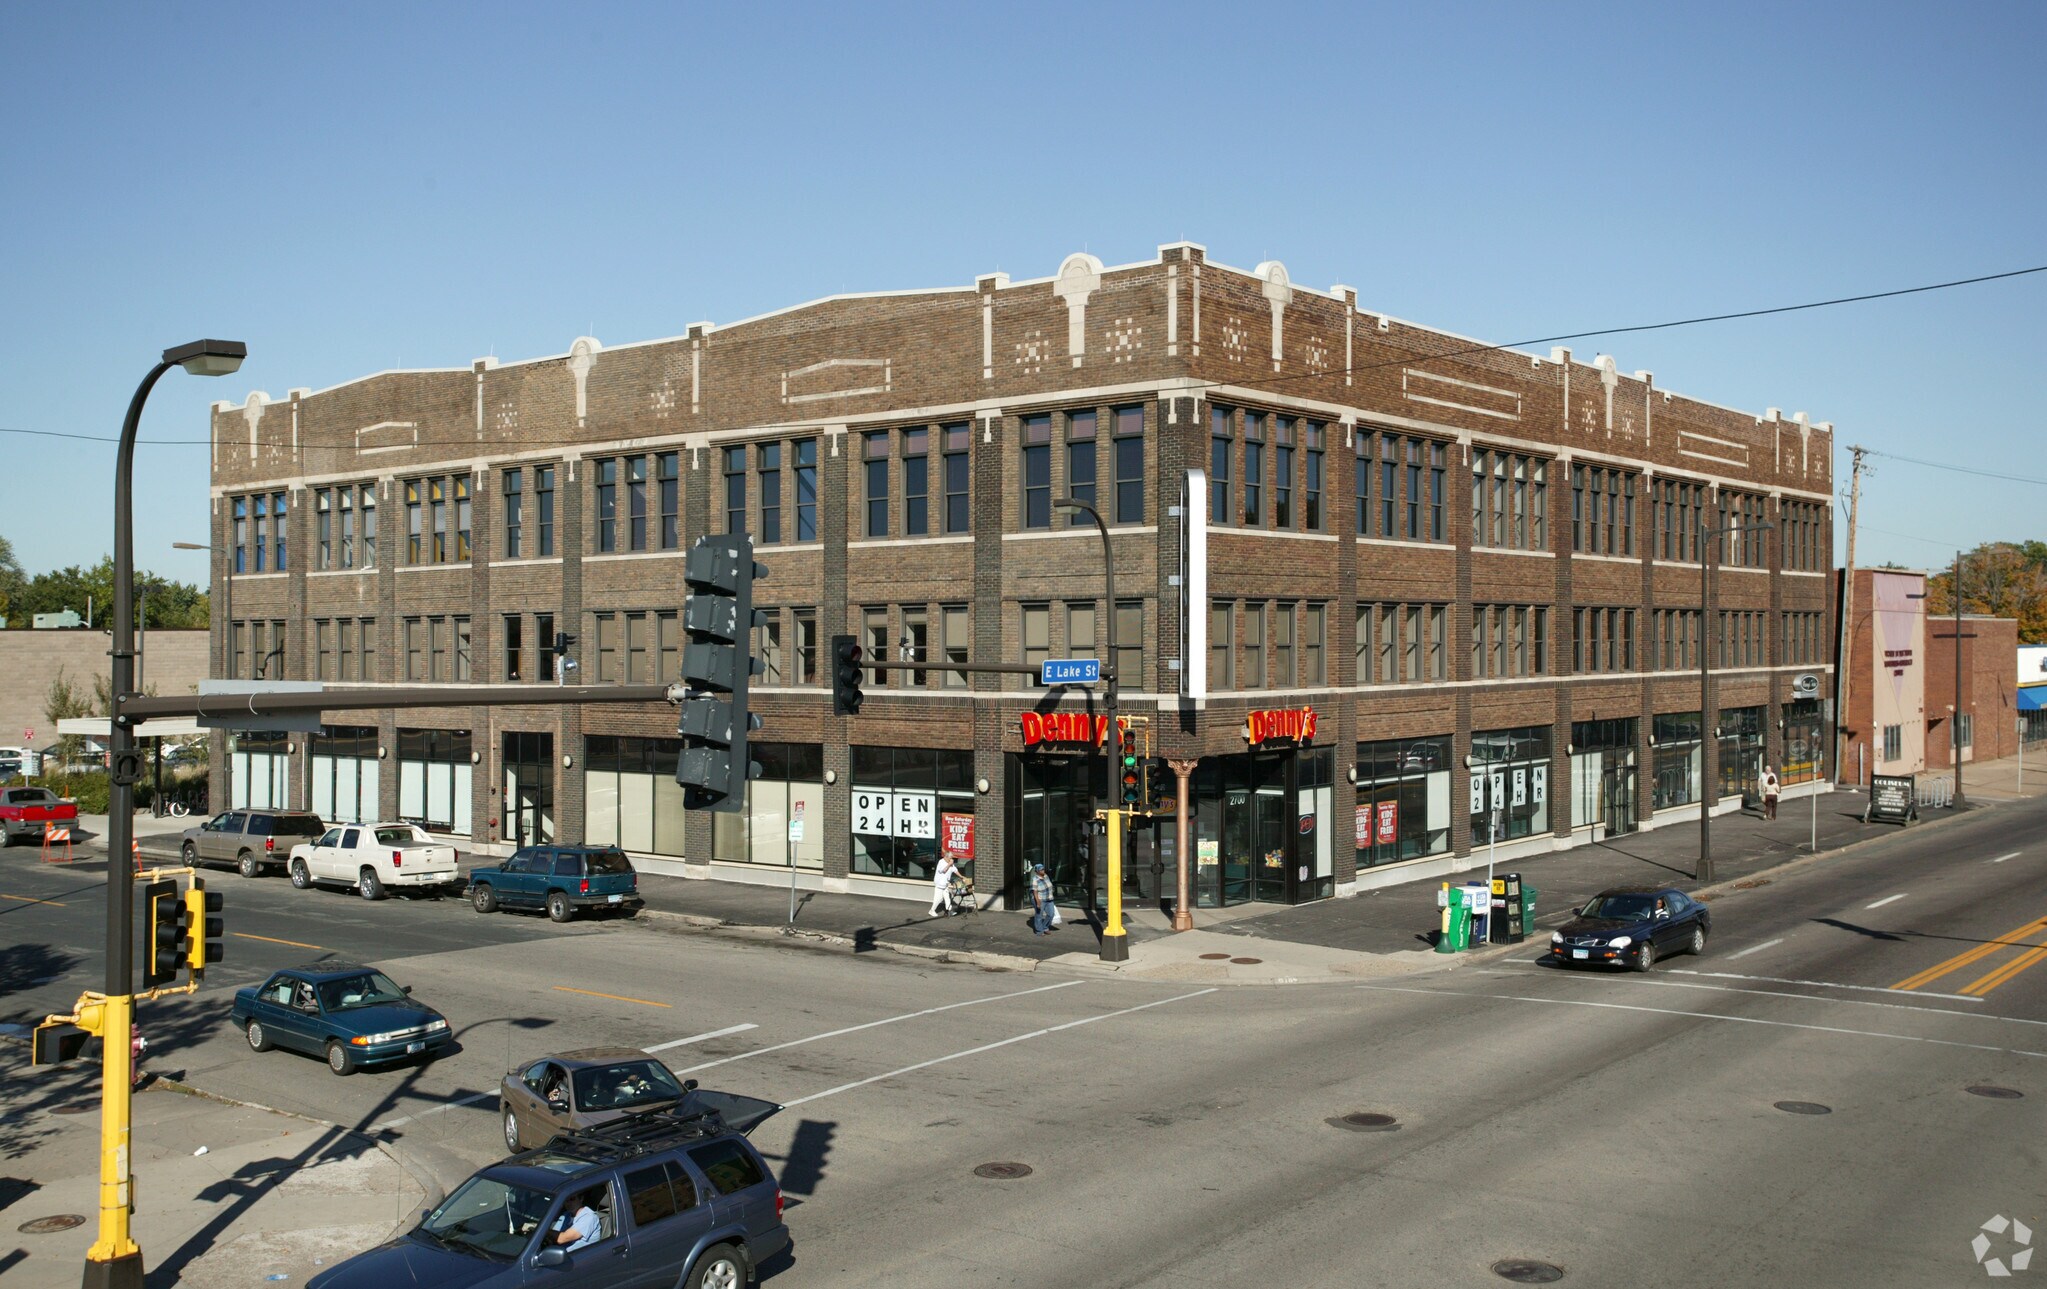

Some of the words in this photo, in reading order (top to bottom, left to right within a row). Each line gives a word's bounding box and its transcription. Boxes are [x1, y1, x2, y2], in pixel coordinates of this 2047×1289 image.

[1046, 665, 1052, 678] E
[1057, 665, 1081, 678] Lake
[1085, 664, 1096, 677] St
[1021, 712, 1127, 747] Dennys
[1248, 705, 1318, 744] Denny's
[1473, 769, 1542, 791] OPEN
[858, 795, 928, 813] OPEN
[1474, 794, 1500, 810] 24
[1516, 787, 1542, 802] HR
[1381, 810, 1393, 819] KIDS
[859, 816, 885, 831] 24
[950, 825, 968, 834] KIDS
[1299, 817, 1314, 832] PEN
[1382, 818, 1391, 827] EAT
[952, 833, 966, 841] EAT
[1380, 825, 1394, 835] FREE!
[948, 840, 969, 850] FREE!
